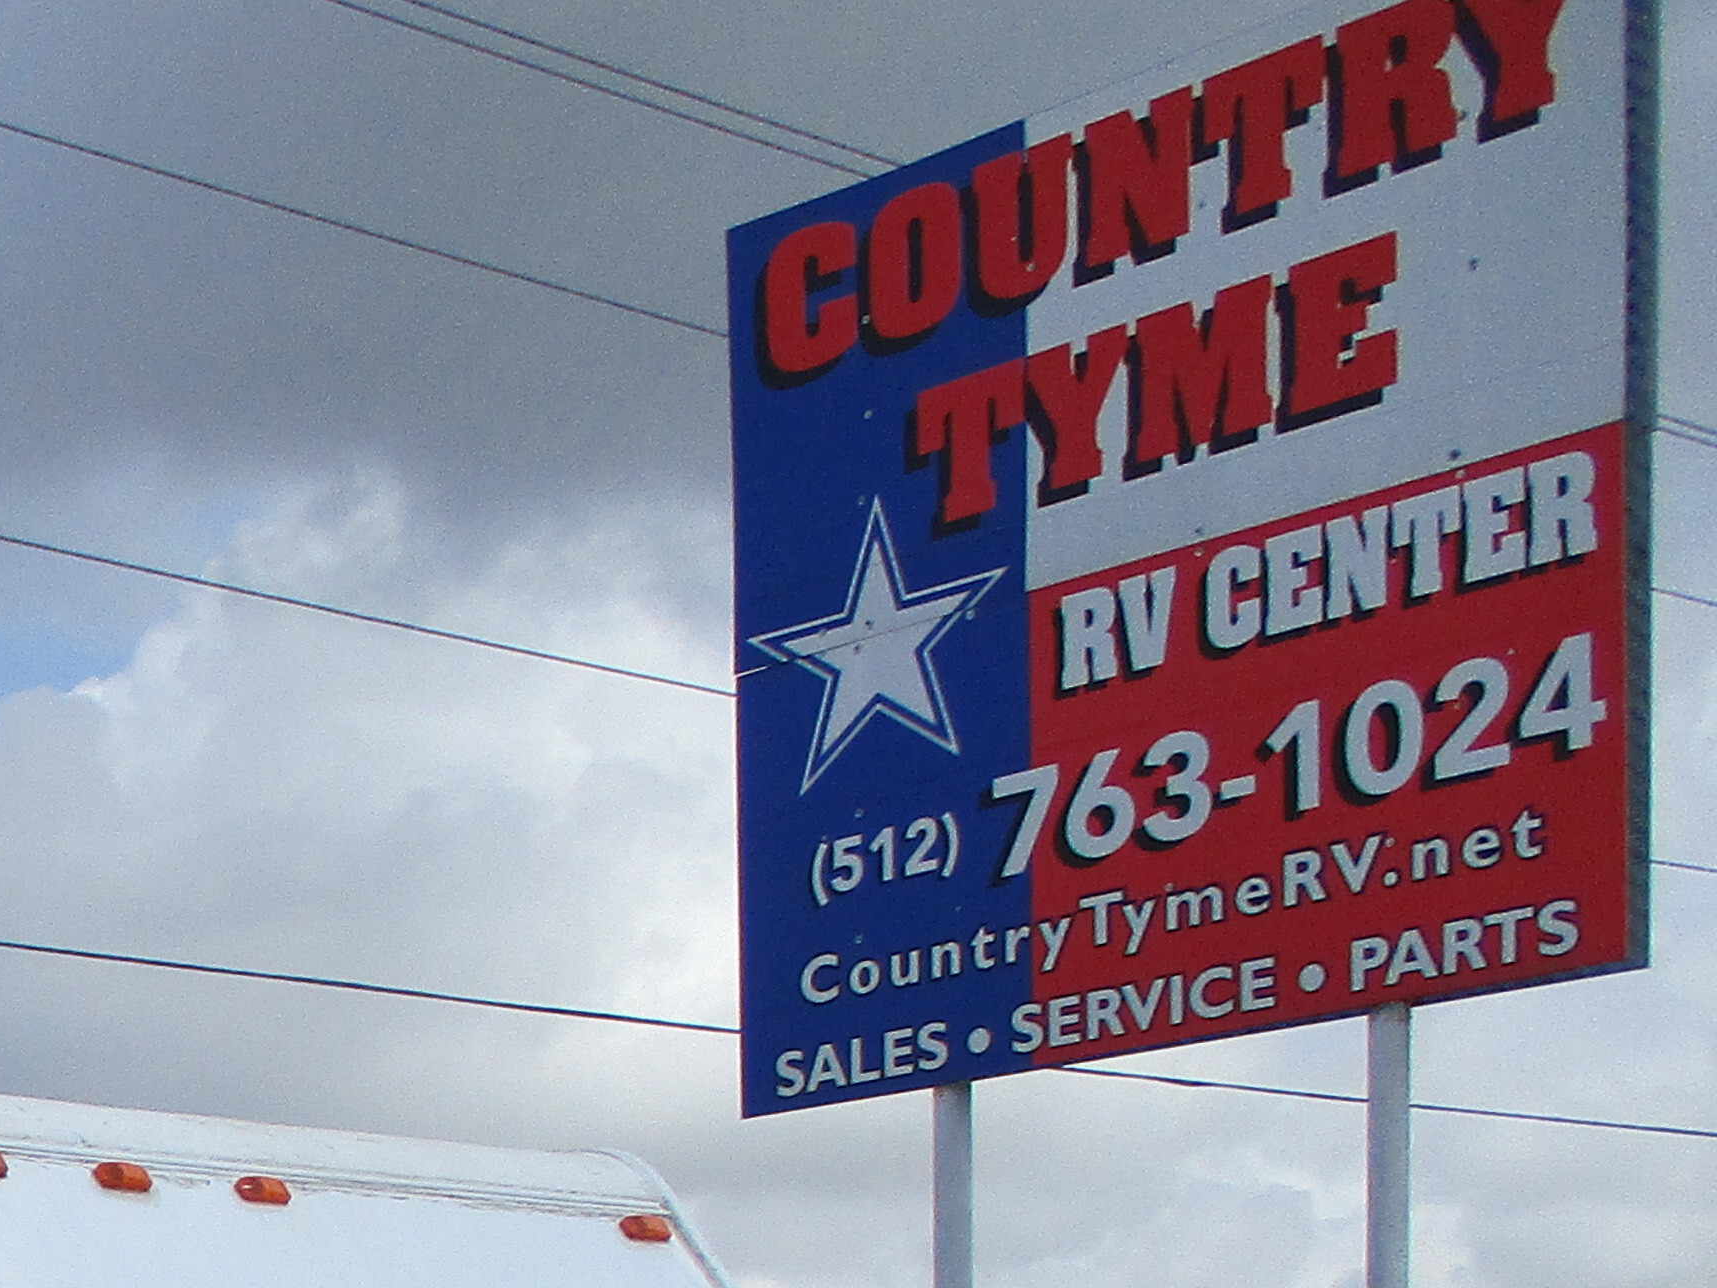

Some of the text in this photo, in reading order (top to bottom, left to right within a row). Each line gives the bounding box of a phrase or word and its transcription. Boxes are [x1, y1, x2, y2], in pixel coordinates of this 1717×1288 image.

[760, 0, 1563, 377] COUNTRY
[911, 231, 1399, 526] TYME
[1060, 450, 1599, 691] RV CENTER
[811, 632, 1607, 907] (512) 763-1024
[774, 899, 1580, 1098] SALES SERVICE PARTS
[799, 809, 1544, 1004] CountryTymeRV.net
